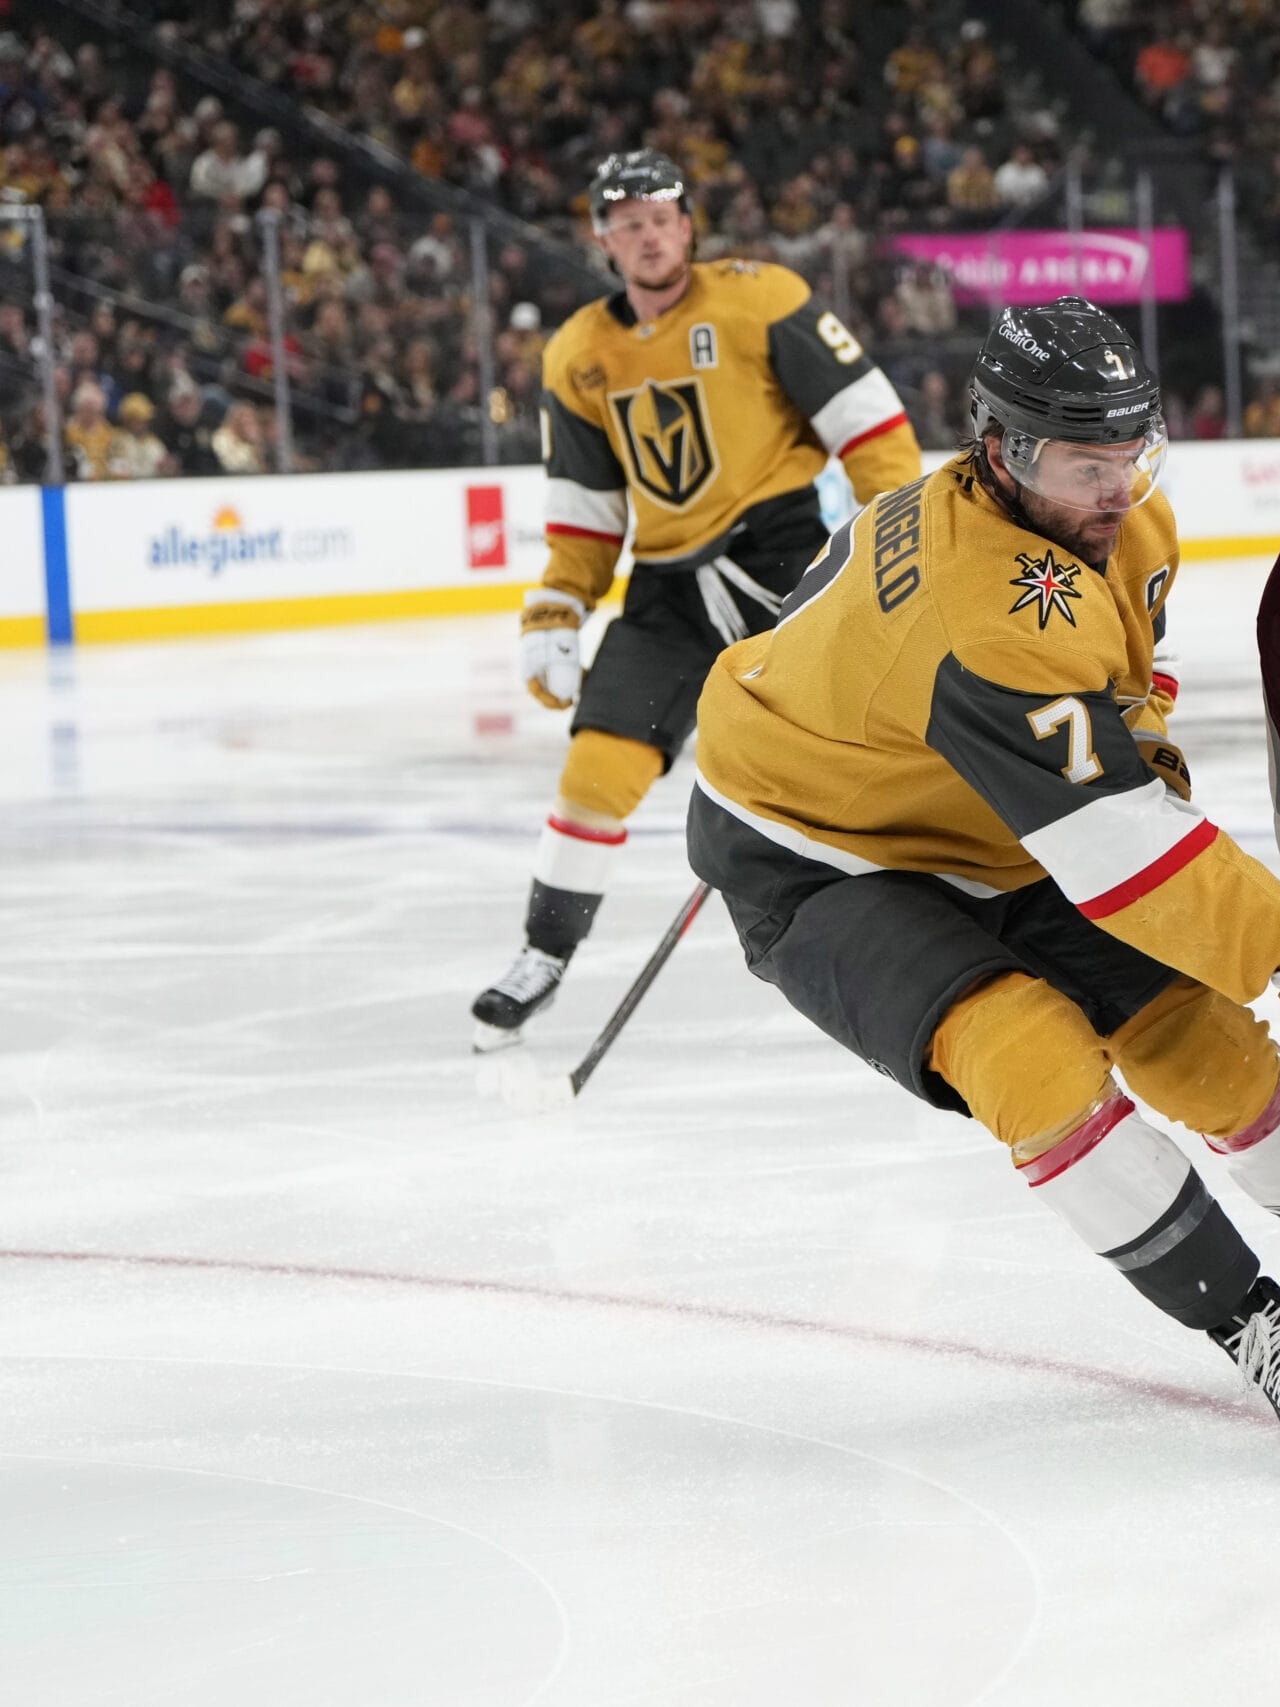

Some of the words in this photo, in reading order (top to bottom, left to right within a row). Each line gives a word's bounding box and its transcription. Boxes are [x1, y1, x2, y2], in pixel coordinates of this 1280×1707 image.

[691, 325, 715, 367] A
[817, 312, 863, 364] 9
[998, 322, 1051, 362] CreditOne
[1104, 354, 1129, 381] 7
[1106, 401, 1150, 418] BAUER
[1025, 694, 1105, 785] 7
